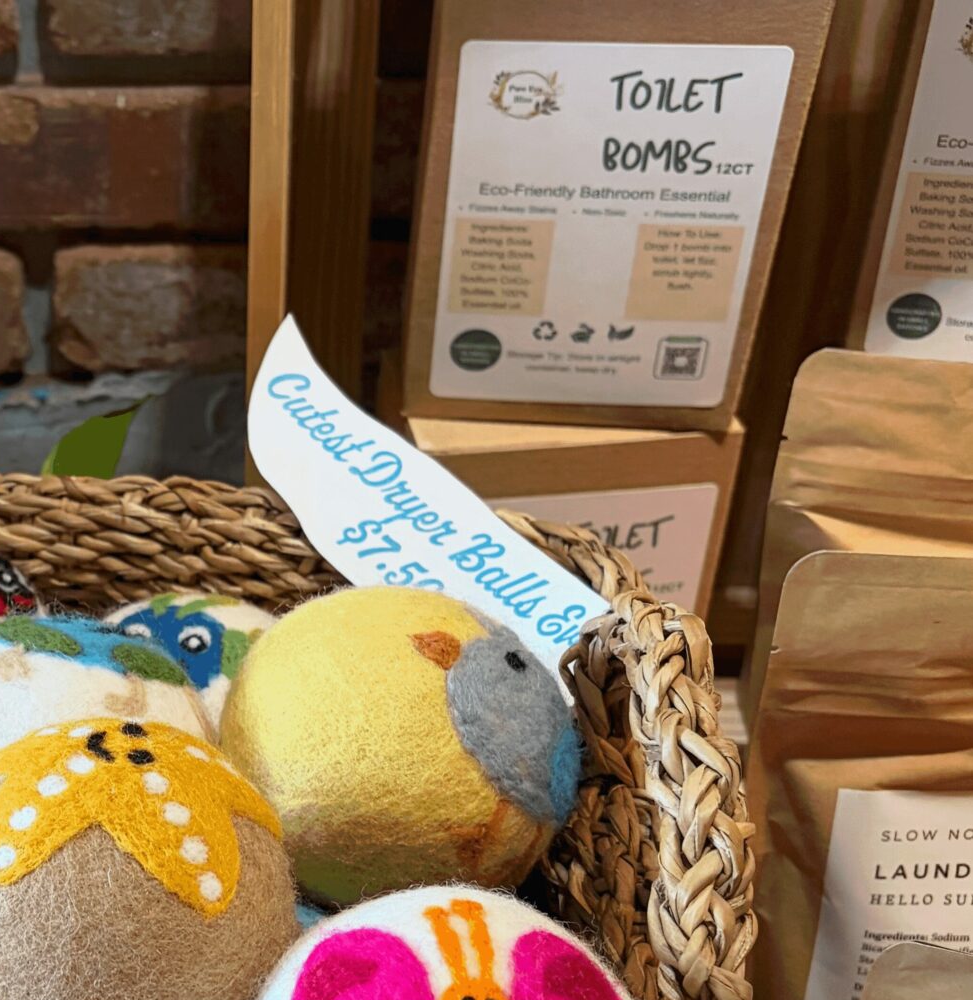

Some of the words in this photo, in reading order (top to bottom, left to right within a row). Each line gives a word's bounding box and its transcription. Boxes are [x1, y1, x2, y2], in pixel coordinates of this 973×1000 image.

[610, 70, 743, 114] TOILET
[602, 137, 716, 175] BOMBS
[716, 163, 754, 176] 12CT
[923, 157, 955, 168] Fizzes
[478, 183, 575, 200] Eco-Friendly
[580, 186, 655, 201] Bathroom
[660, 189, 731, 203] Essential
[919, 191, 956, 204] Baking
[910, 205, 956, 219] Washing
[905, 233, 945, 245] Sodium
[267, 373, 376, 463] Cutest
[348, 450, 457, 546] Dryer
[448, 532, 550, 619] Balls
[881, 829, 938, 843] SLOW
[874, 863, 971, 880] LAUND
[870, 893, 934, 906] HELLO
[930, 931, 971, 943] Sodium
